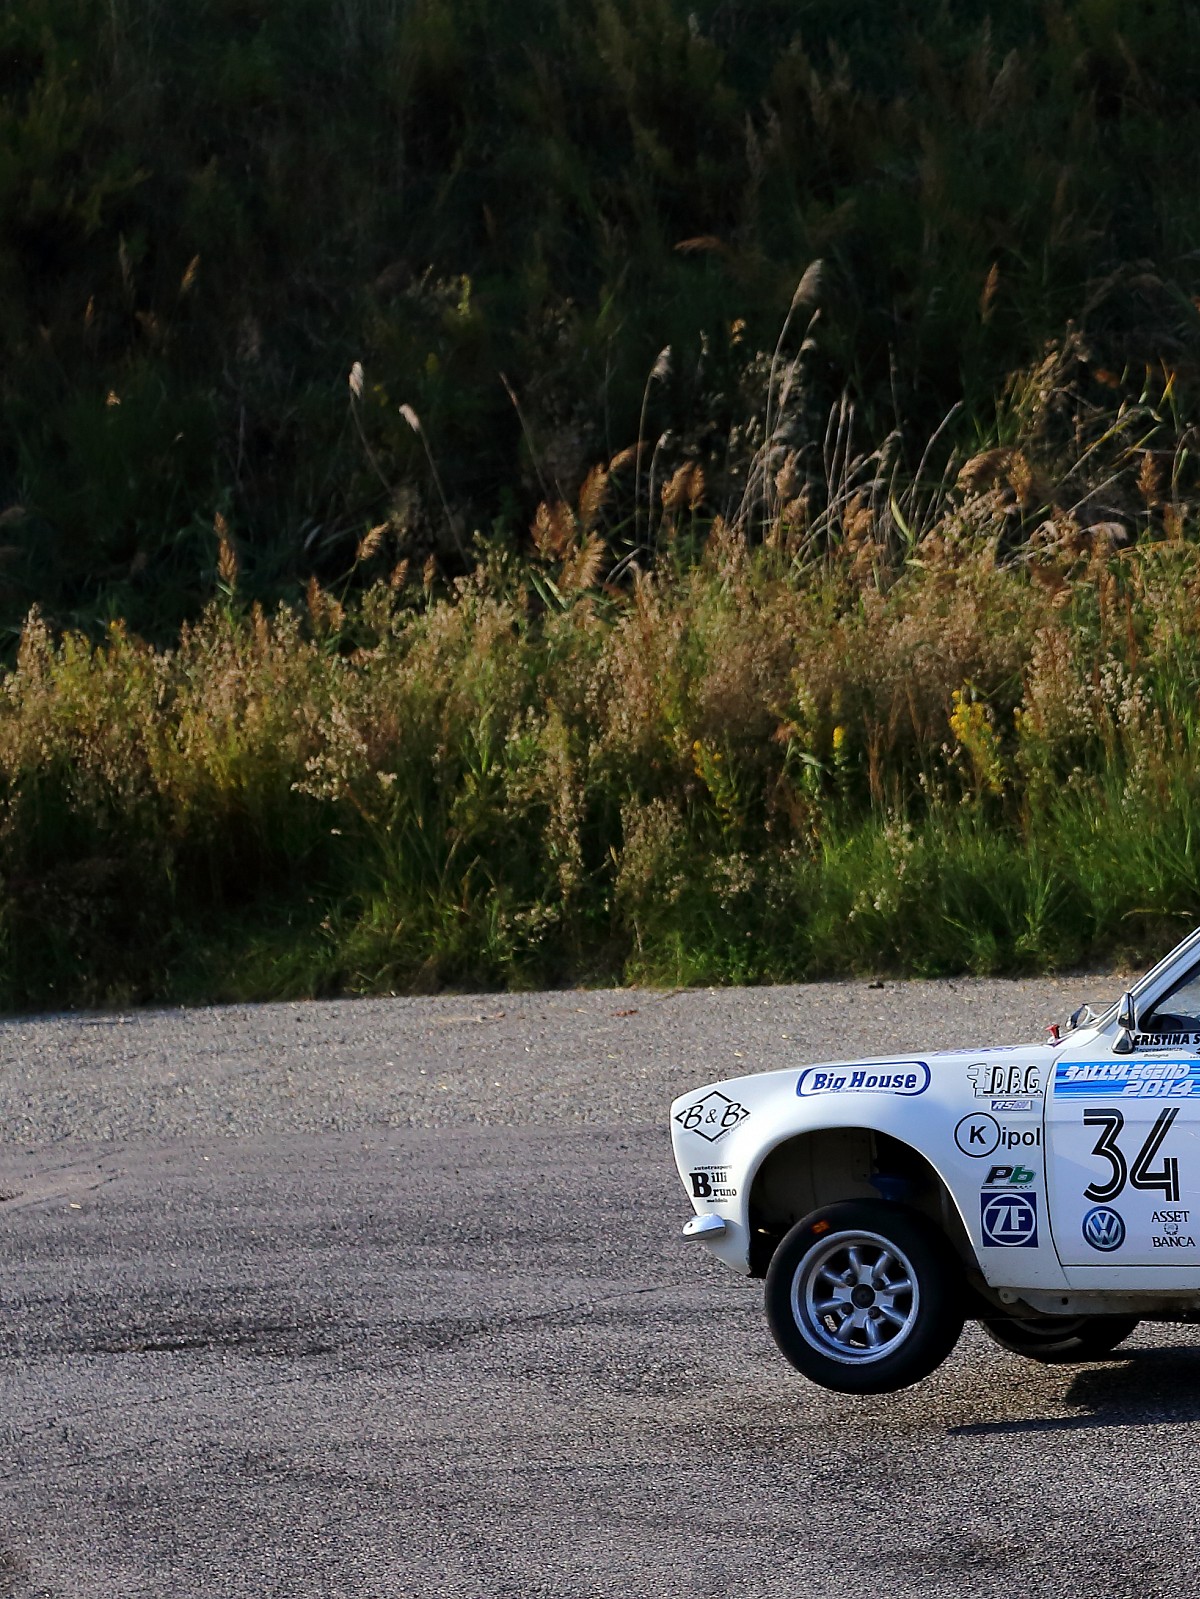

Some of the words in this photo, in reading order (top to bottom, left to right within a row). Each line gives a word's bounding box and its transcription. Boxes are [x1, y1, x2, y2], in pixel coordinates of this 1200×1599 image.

[1133, 1034, 1190, 1046] CRISTINA
[810, 1072, 847, 1090] Big
[848, 1071, 917, 1089] House
[1065, 1063, 1191, 1081] RALLYLEGEND
[1121, 1079, 1195, 1098] 2014
[1082, 1108, 1181, 1204] 34
[1150, 1210, 1190, 1223] ASSET
[1151, 1236, 1196, 1248] BANCA
